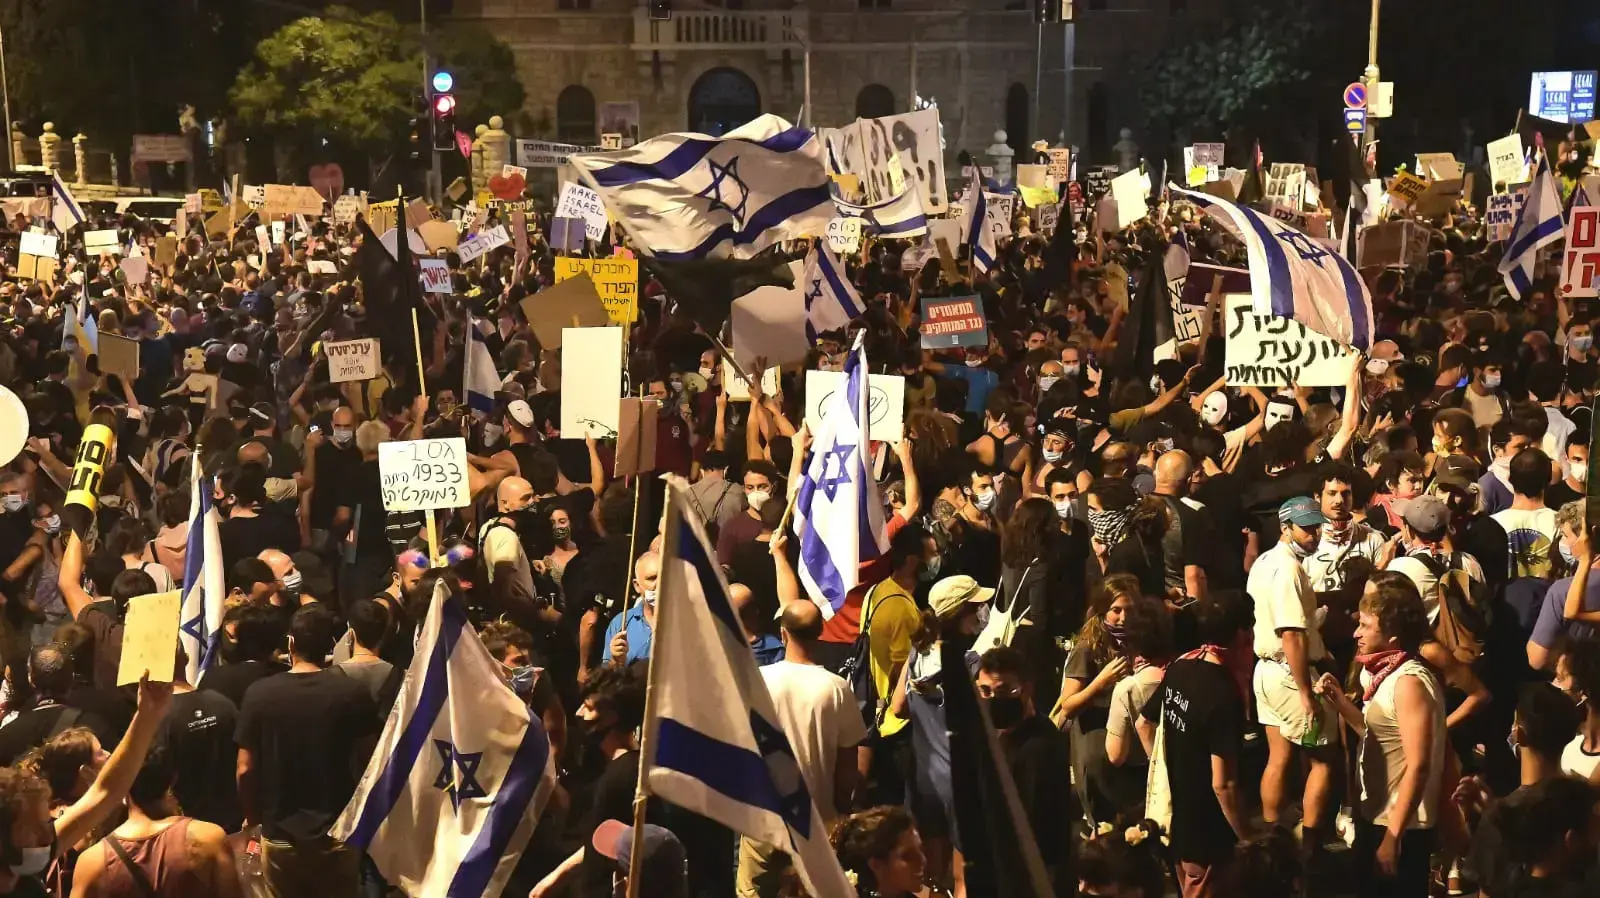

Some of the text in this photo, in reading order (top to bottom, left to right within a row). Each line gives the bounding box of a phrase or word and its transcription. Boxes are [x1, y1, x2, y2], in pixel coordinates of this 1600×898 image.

[568, 186, 598, 202] MAKE
[565, 196, 604, 217] ISRAEL
[925, 316, 983, 334] נגד המנותקים
[384, 463, 462, 488] 1933 היתה
[382, 486, 458, 506] דמוקרטיה!
